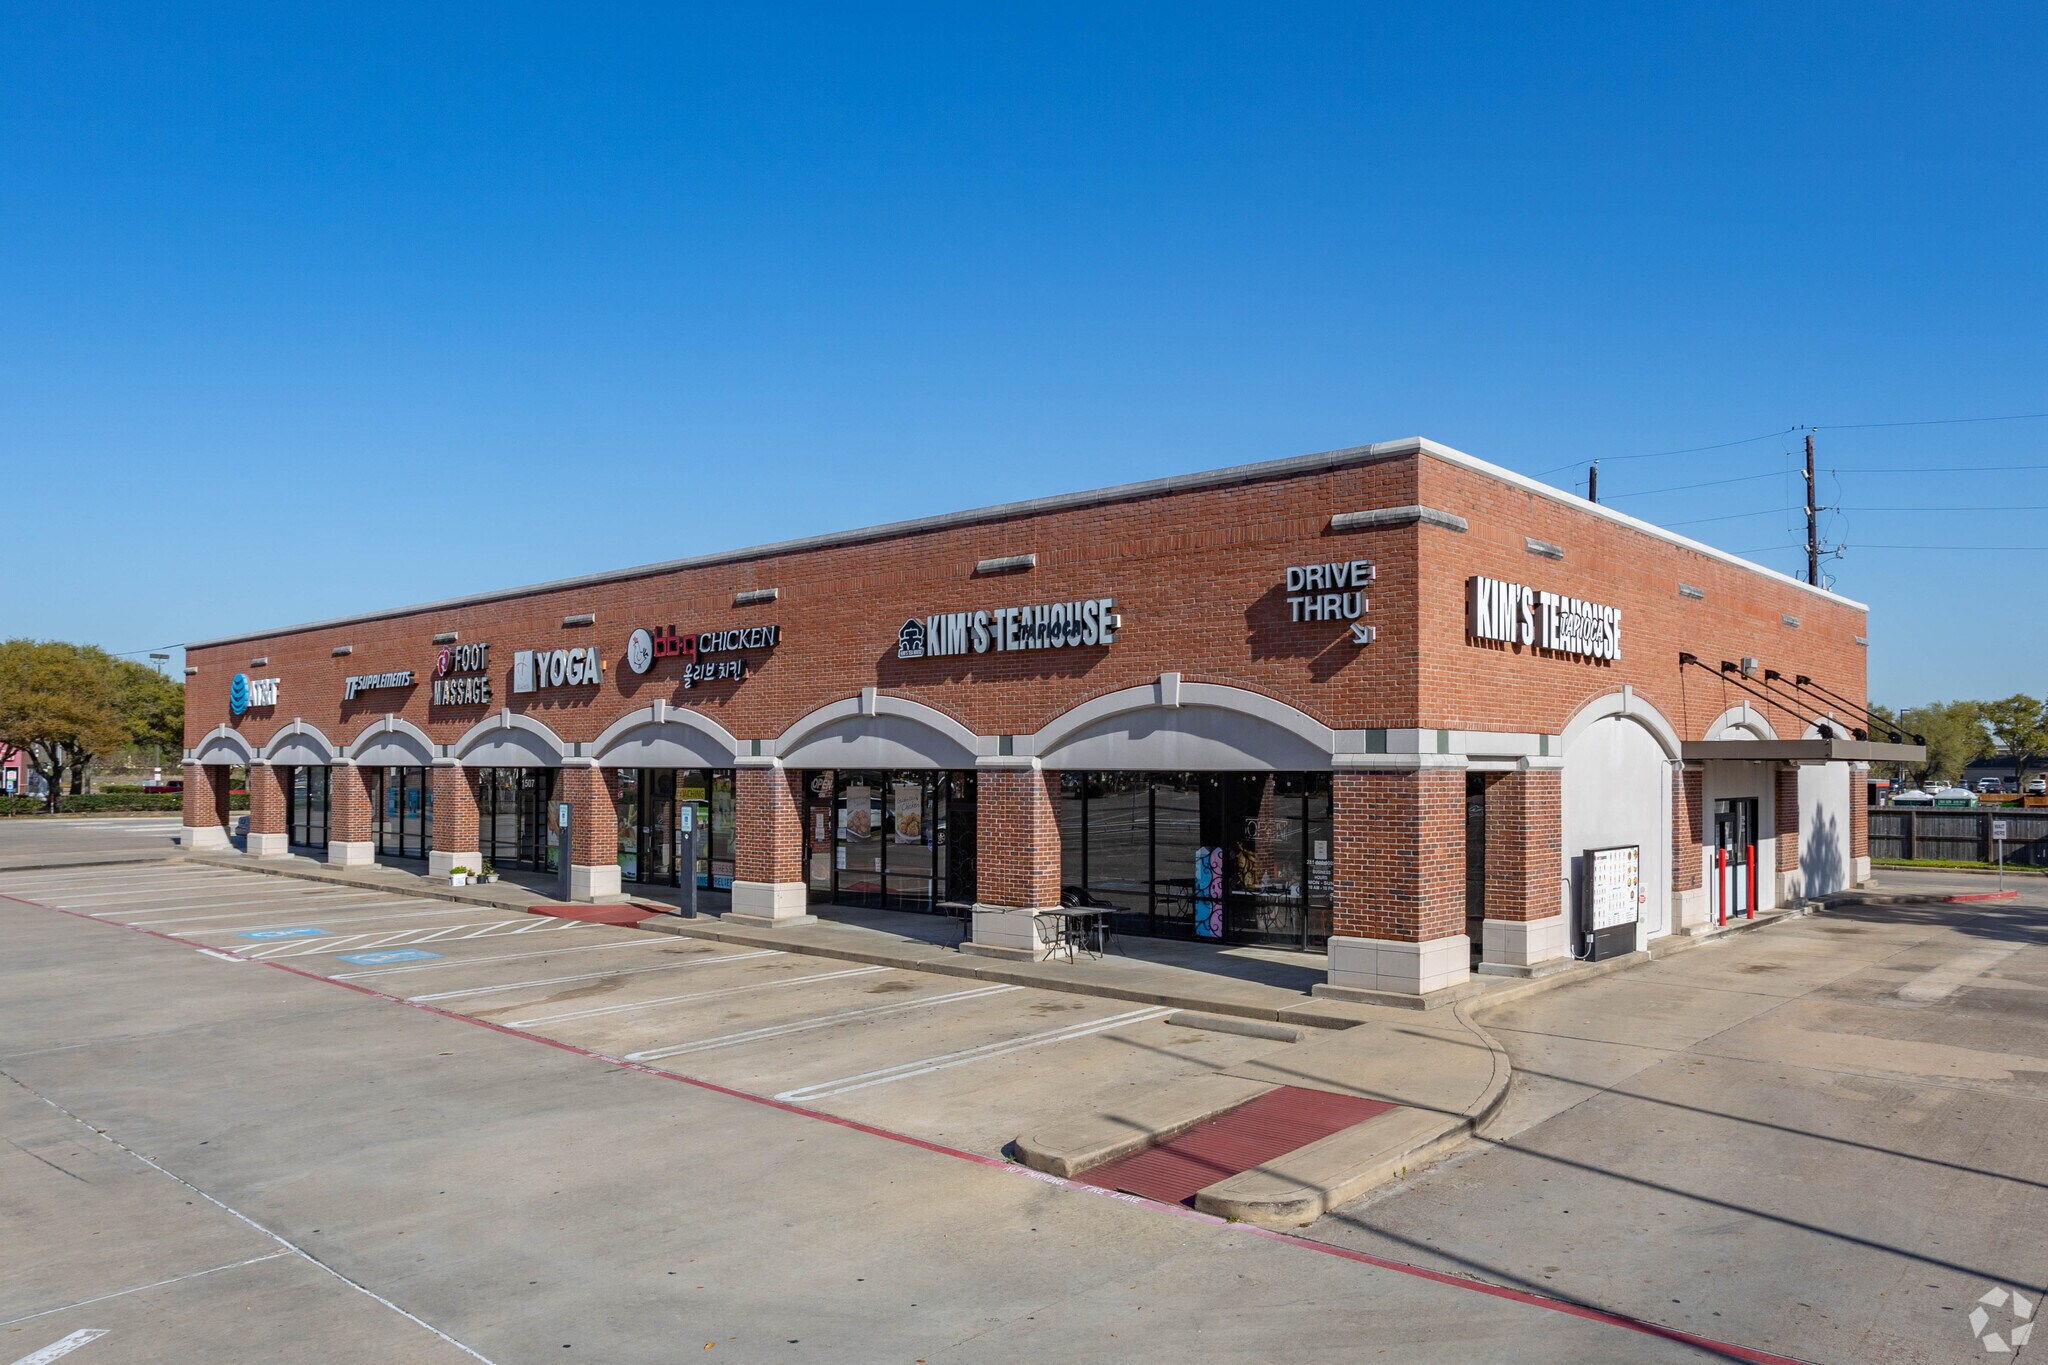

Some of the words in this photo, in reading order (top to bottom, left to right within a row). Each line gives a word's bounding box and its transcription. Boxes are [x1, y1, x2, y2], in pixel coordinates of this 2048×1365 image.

[1285, 560, 1372, 592] DRIVE
[1286, 592, 1364, 622] THRU
[1475, 576, 1535, 646] KIM'S
[699, 626, 775, 654] CHICKEN
[926, 610, 990, 657] KIM'S
[993, 597, 1115, 652] TEAHOUSE
[454, 643, 489, 672] FOOT
[536, 646, 598, 687] YOGA
[357, 671, 411, 690] SUPPLEMENTS
[683, 661, 716, 689] 올리브
[718, 659, 742, 682] 치킨
[248, 678, 280, 707] AT&T
[433, 677, 489, 706] MASSAGE
[521, 779, 535, 789] 1507
[812, 777, 833, 791] OPEN
